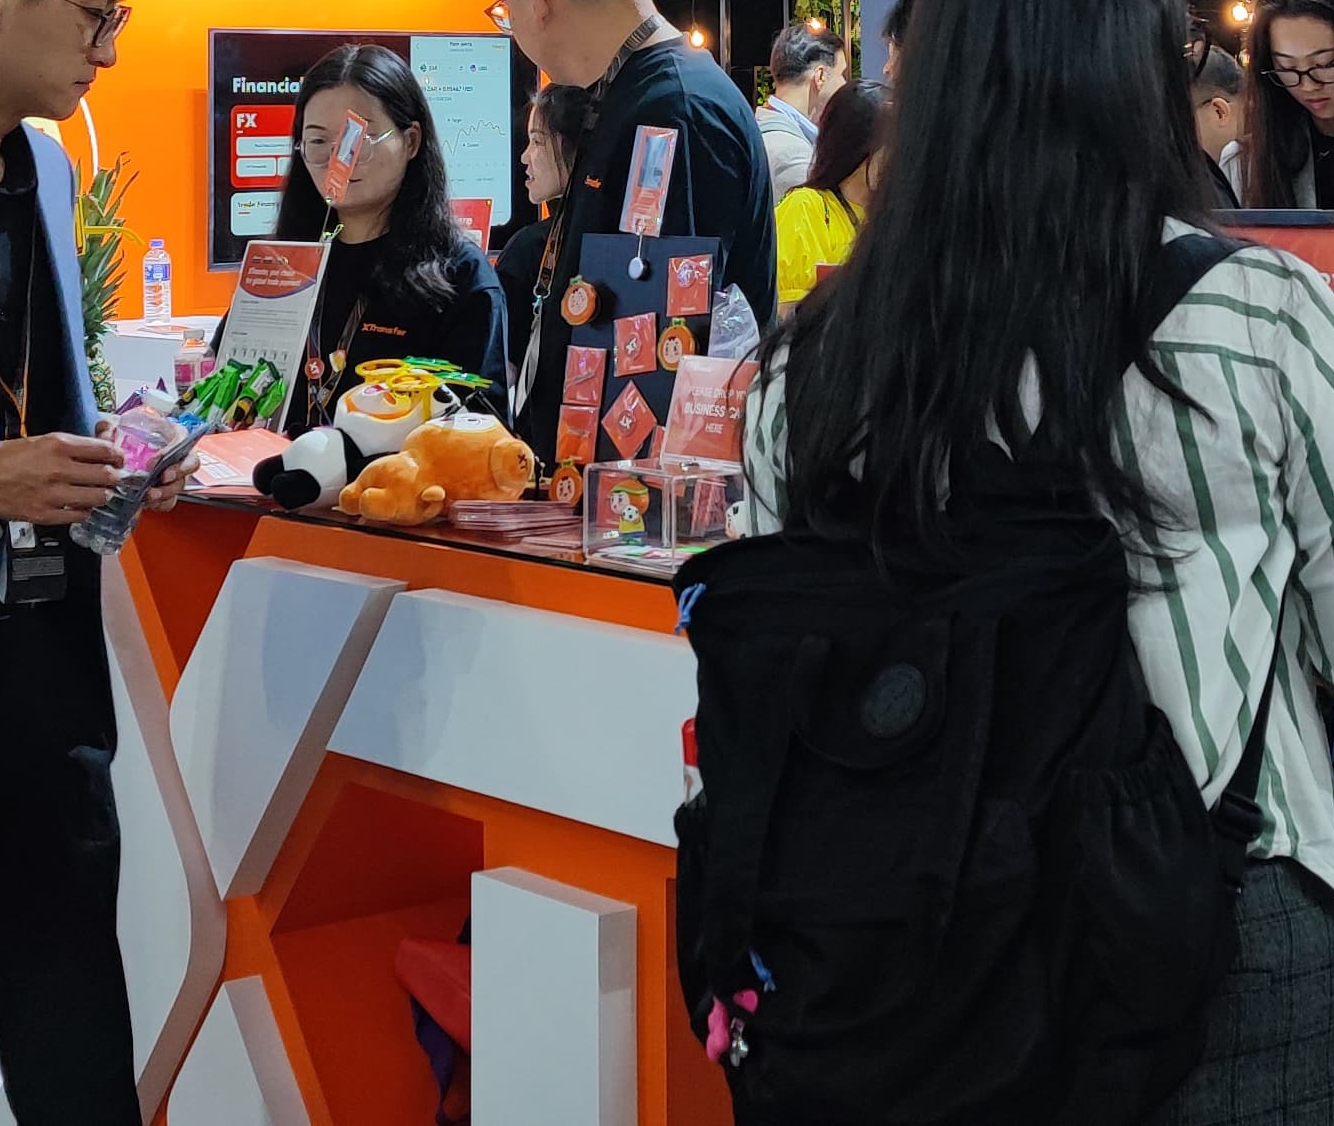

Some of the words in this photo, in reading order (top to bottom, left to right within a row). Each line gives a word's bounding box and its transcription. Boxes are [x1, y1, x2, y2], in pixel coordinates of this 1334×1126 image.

[236, 113, 258, 129] FX
[361, 322, 407, 337] XTransfer
[684, 401, 727, 418] BUSINESS
